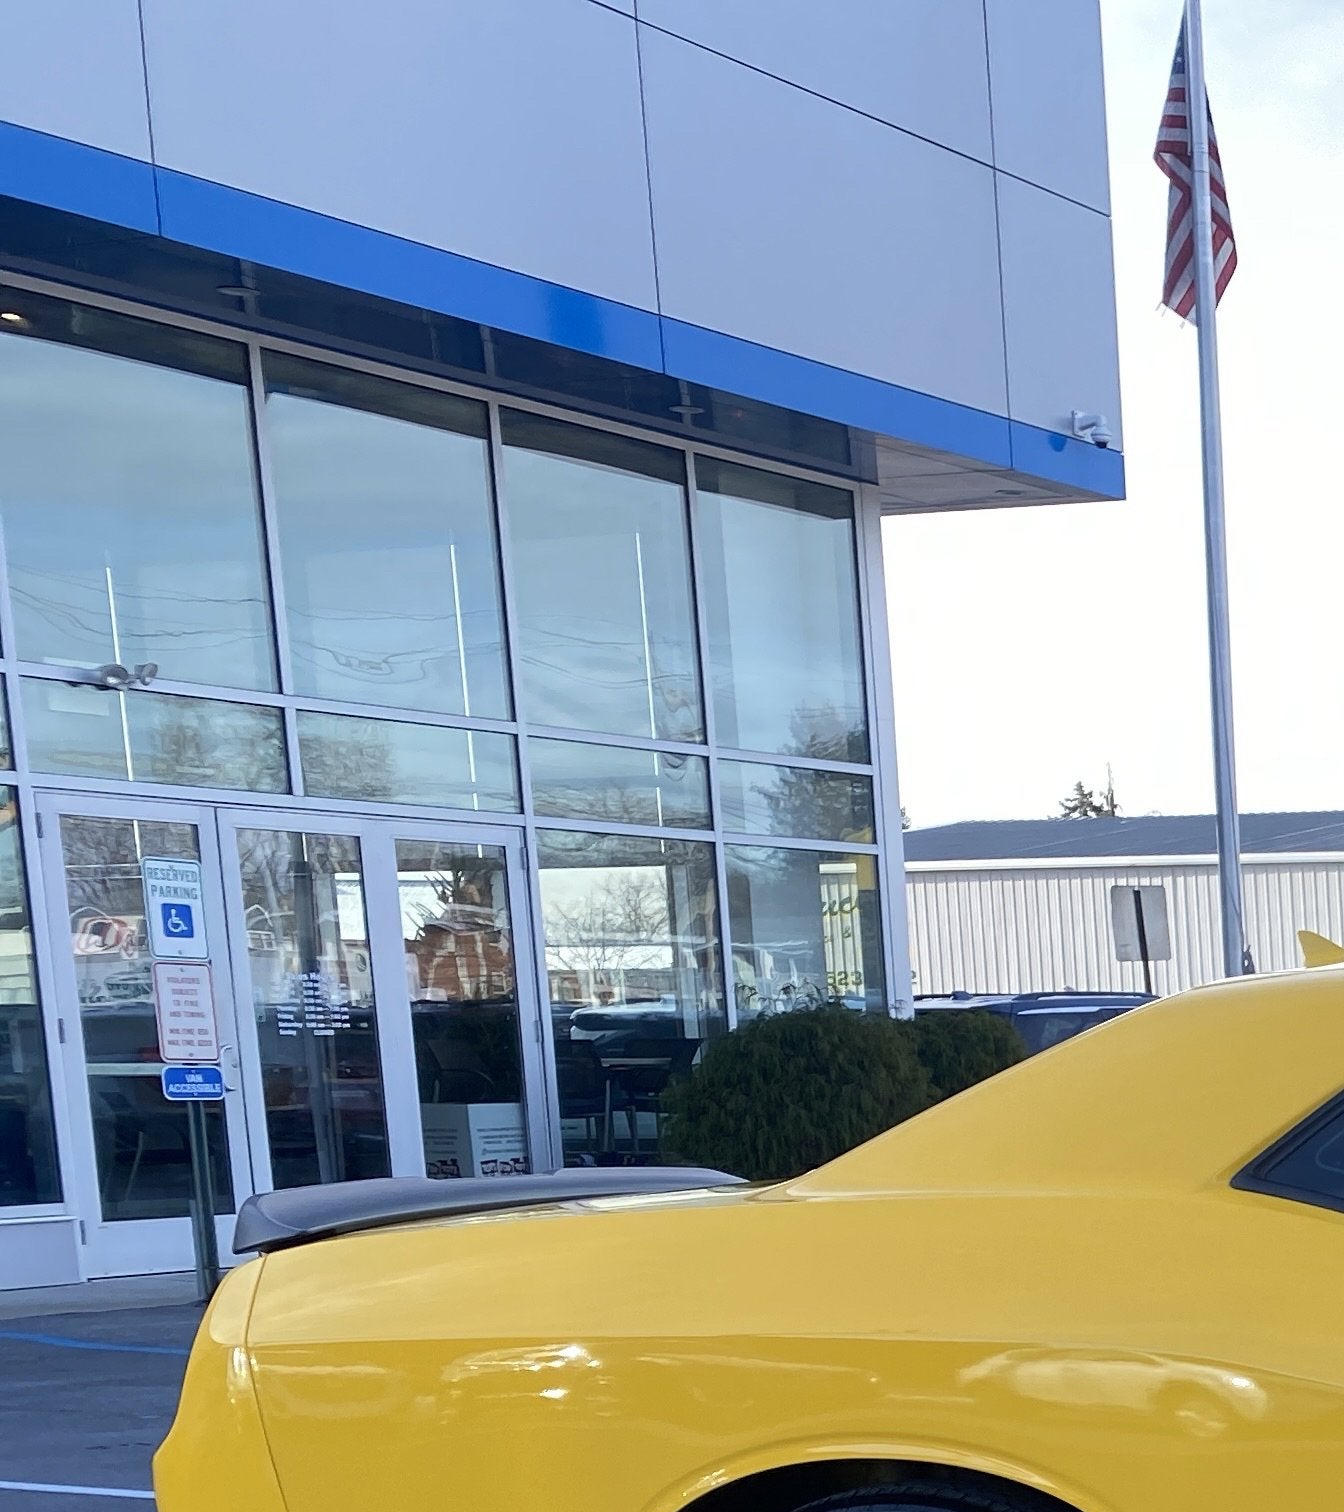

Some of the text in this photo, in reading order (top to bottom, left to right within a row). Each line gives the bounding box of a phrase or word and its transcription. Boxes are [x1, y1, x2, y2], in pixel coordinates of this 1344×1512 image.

[146, 867, 198, 882] RESERVED
[150, 885, 199, 900] PARKING
[185, 1073, 204, 1083] VAN
